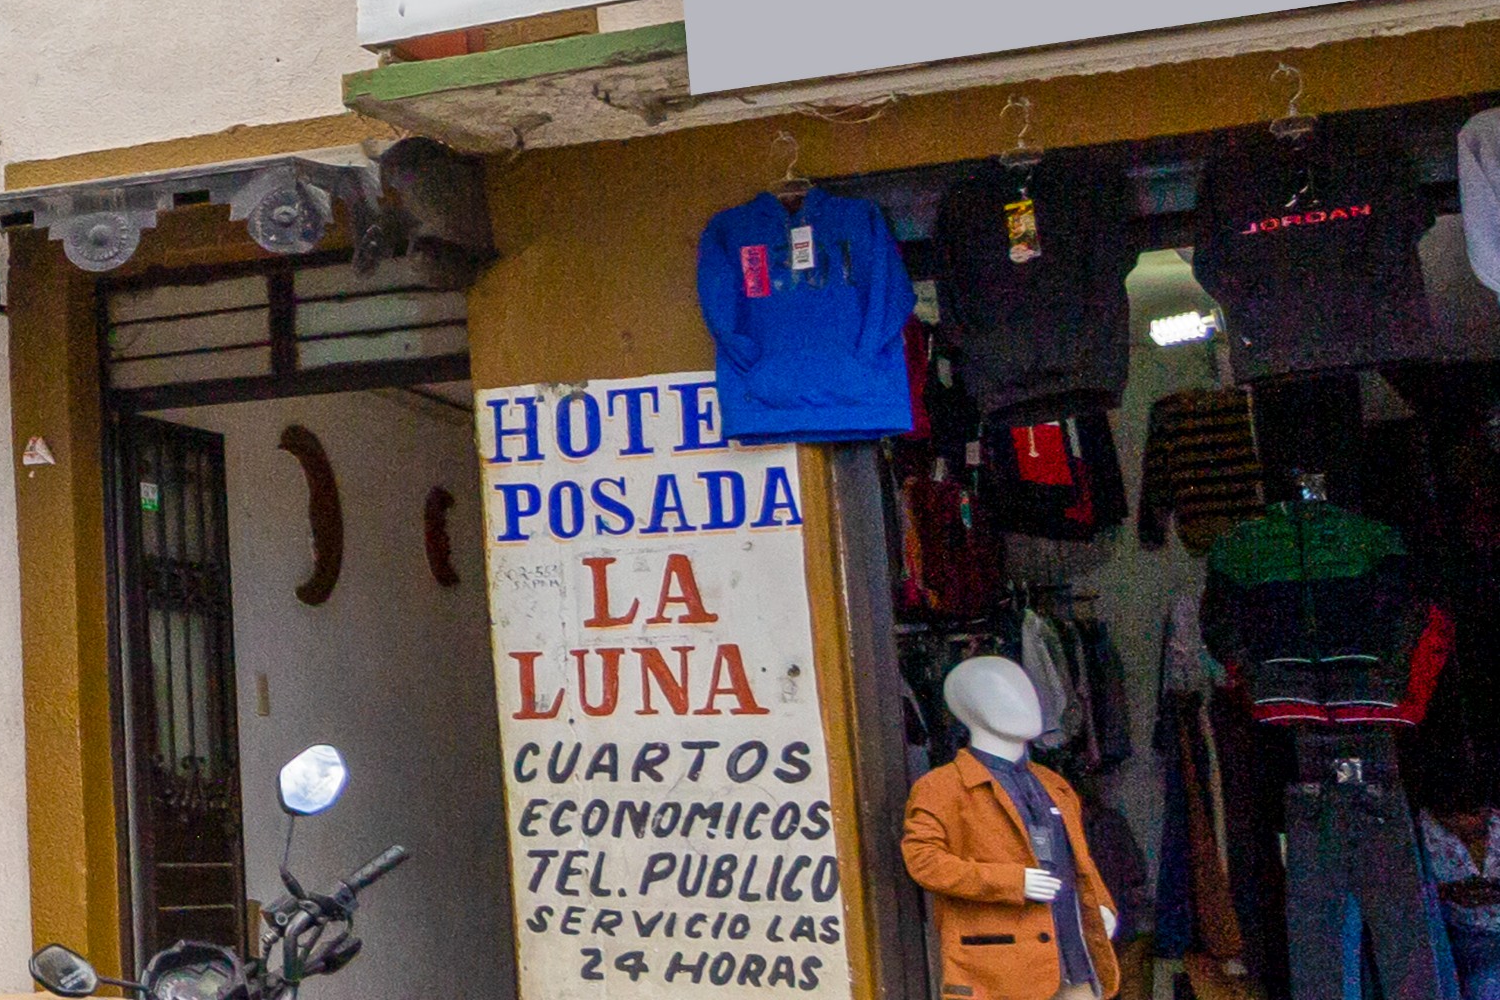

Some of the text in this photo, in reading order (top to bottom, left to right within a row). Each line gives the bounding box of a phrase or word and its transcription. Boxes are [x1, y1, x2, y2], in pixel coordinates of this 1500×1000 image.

[1241, 203, 1372, 234] JORDAN
[486, 381, 787, 463] HOTE
[494, 466, 803, 541] POSADA
[581, 553, 718, 629] LA
[508, 643, 770, 720] LUNA
[513, 740, 812, 784] CUARTOS
[517, 798, 831, 840] ECONOMICOS
[527, 850, 839, 902] TEL. PUBLICO
[526, 905, 840, 944] SERVICIO LAS
[580, 948, 823, 990] 24 HORAS
